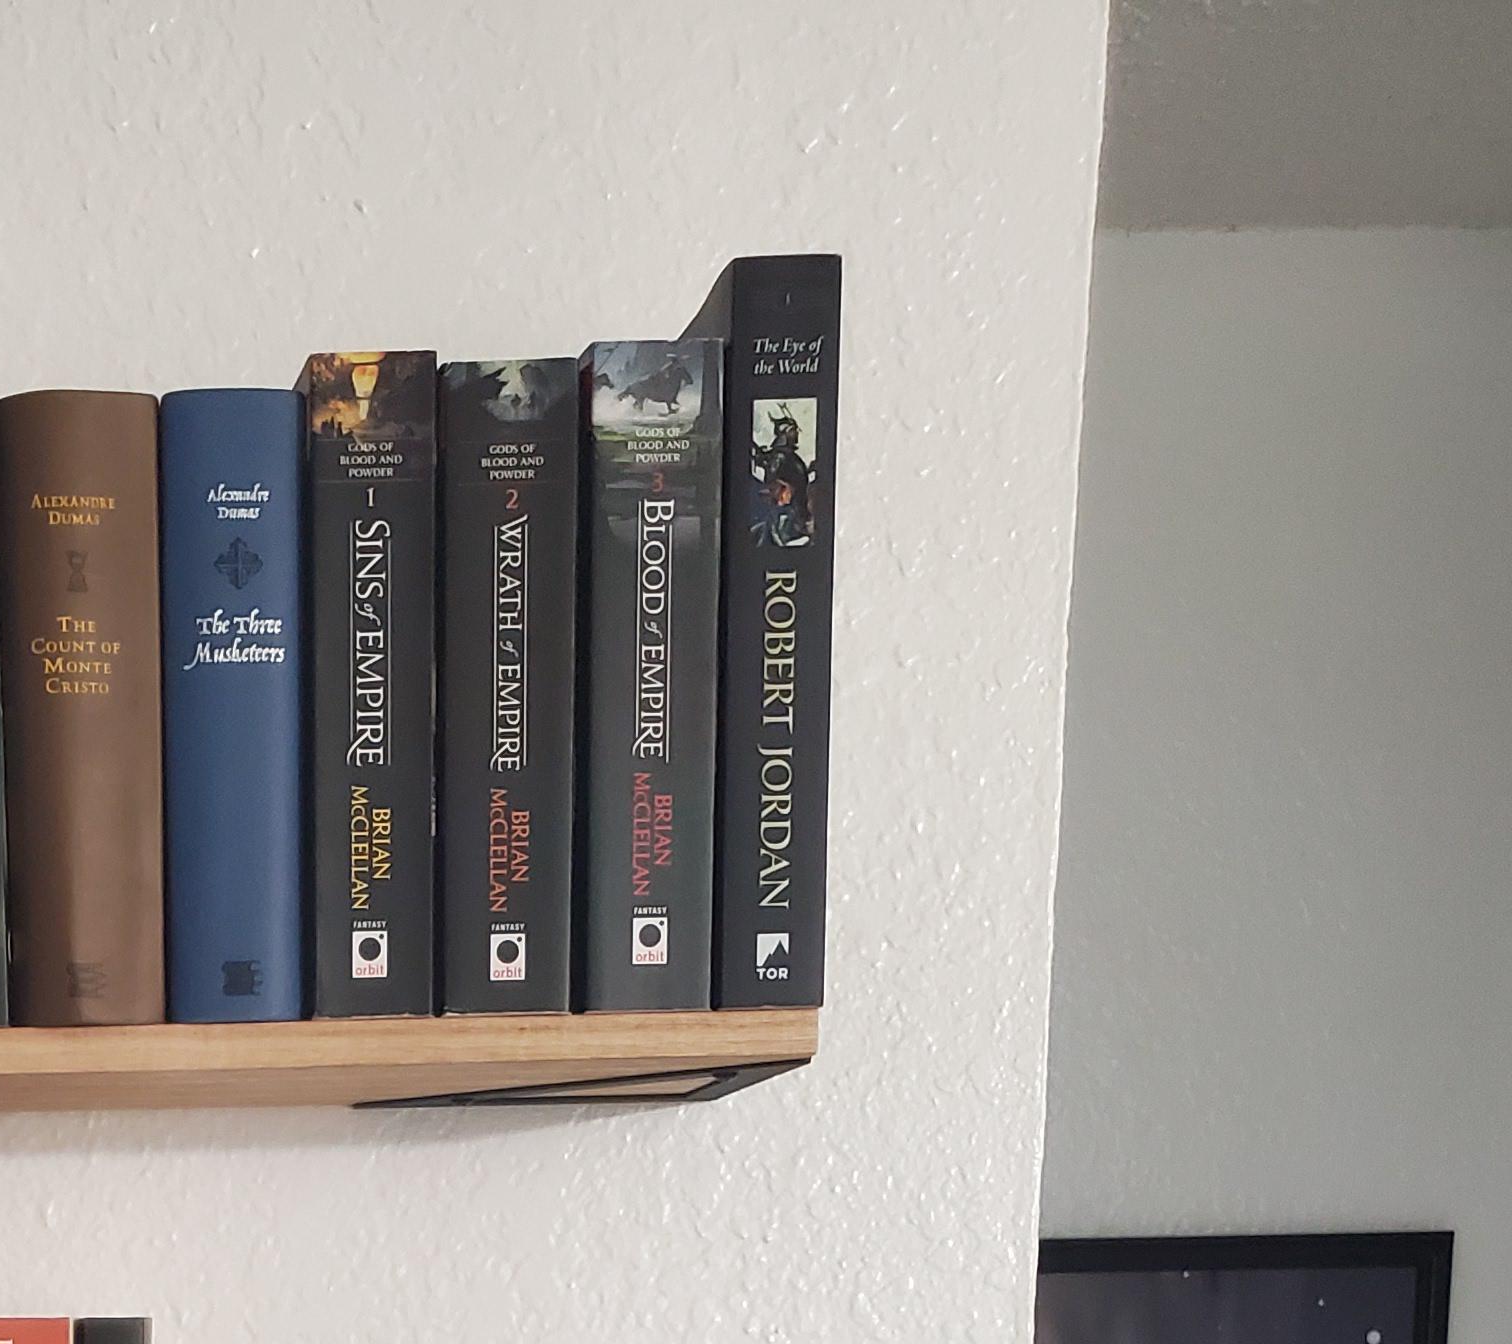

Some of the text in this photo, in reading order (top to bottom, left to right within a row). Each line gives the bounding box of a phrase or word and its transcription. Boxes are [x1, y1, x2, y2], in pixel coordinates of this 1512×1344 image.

[754, 336, 824, 354] The Eye of
[754, 358, 819, 375] the World
[490, 444, 535, 454] GODS OF
[481, 456, 544, 467] BLOOD AND
[490, 470, 534, 480] POWDER
[31, 494, 115, 510] ALEXANDRE
[49, 511, 99, 526] DUMAS
[498, 514, 528, 631] WRATH
[56, 616, 96, 632] THE
[196, 608, 282, 635] The Three
[31, 638, 96, 654] COUNT
[346, 519, 390, 767] SINS of EMPIRE
[183, 637, 285, 671] Musketeers
[44, 658, 112, 674] MONTE
[46, 677, 109, 694] CRISTO
[758, 570, 798, 909] ROBERT JORDAN
[511, 810, 530, 882] BRIAN
[355, 965, 384, 975] orbit
[757, 968, 788, 980] TOR
